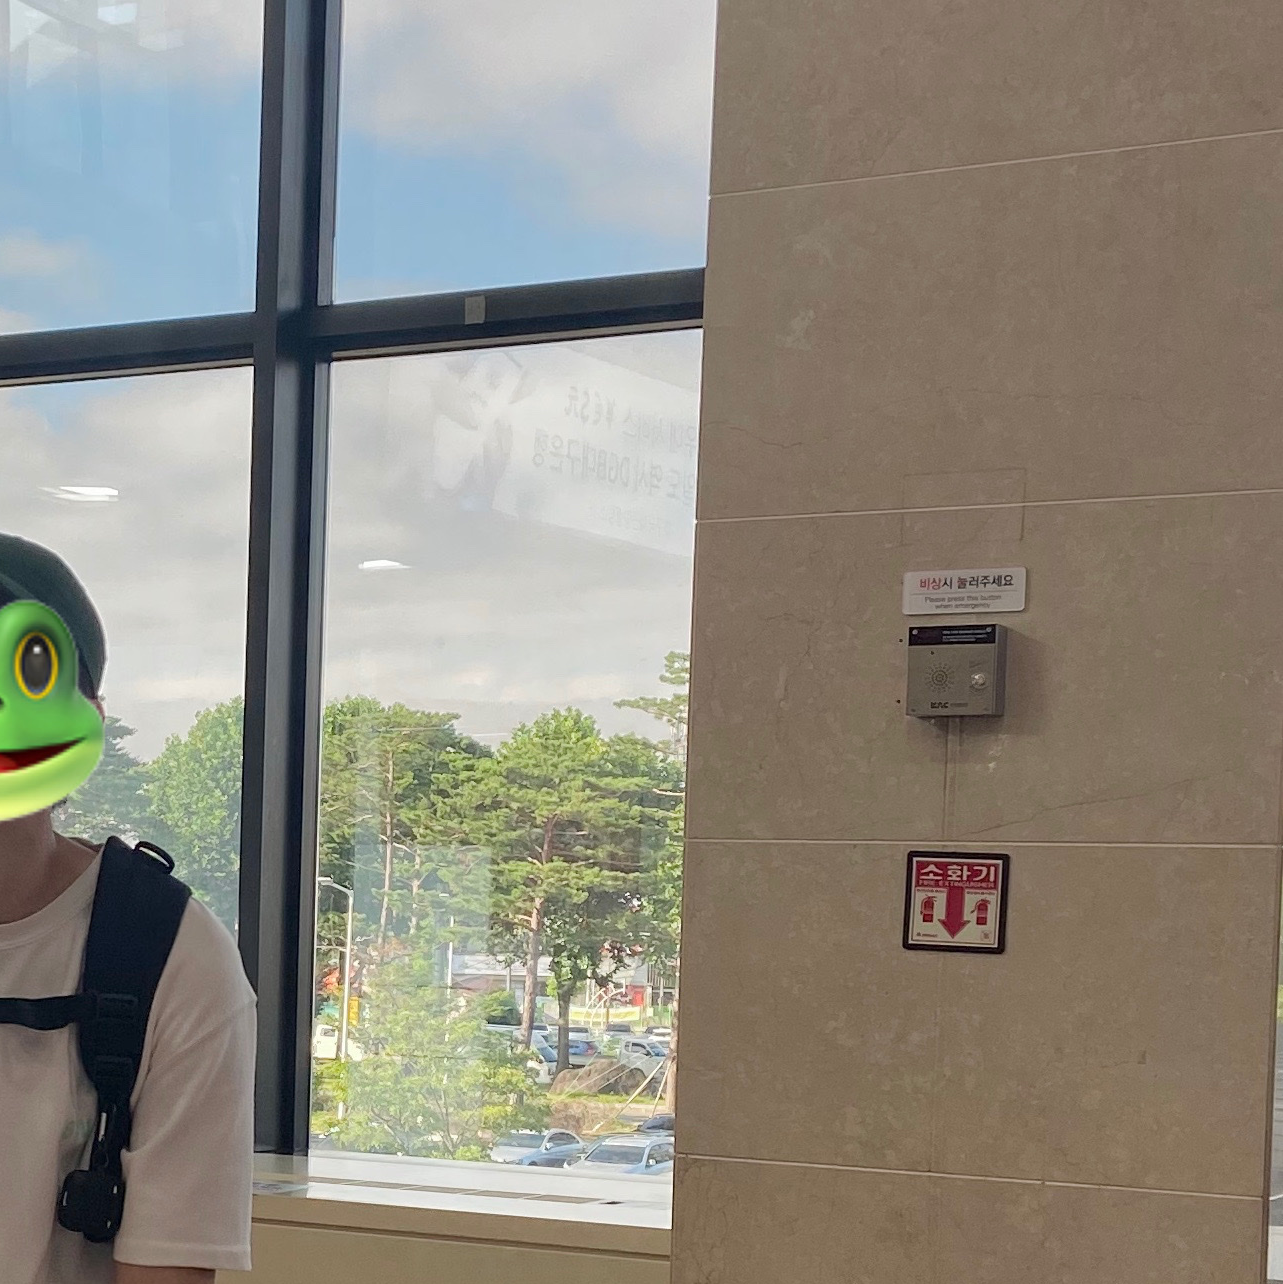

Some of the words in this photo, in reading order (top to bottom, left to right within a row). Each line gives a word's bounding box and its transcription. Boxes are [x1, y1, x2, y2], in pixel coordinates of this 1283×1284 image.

[919, 577, 953, 590] 비상시
[957, 574, 1014, 590] 눌러주세요
[919, 864, 996, 882] 소화기
